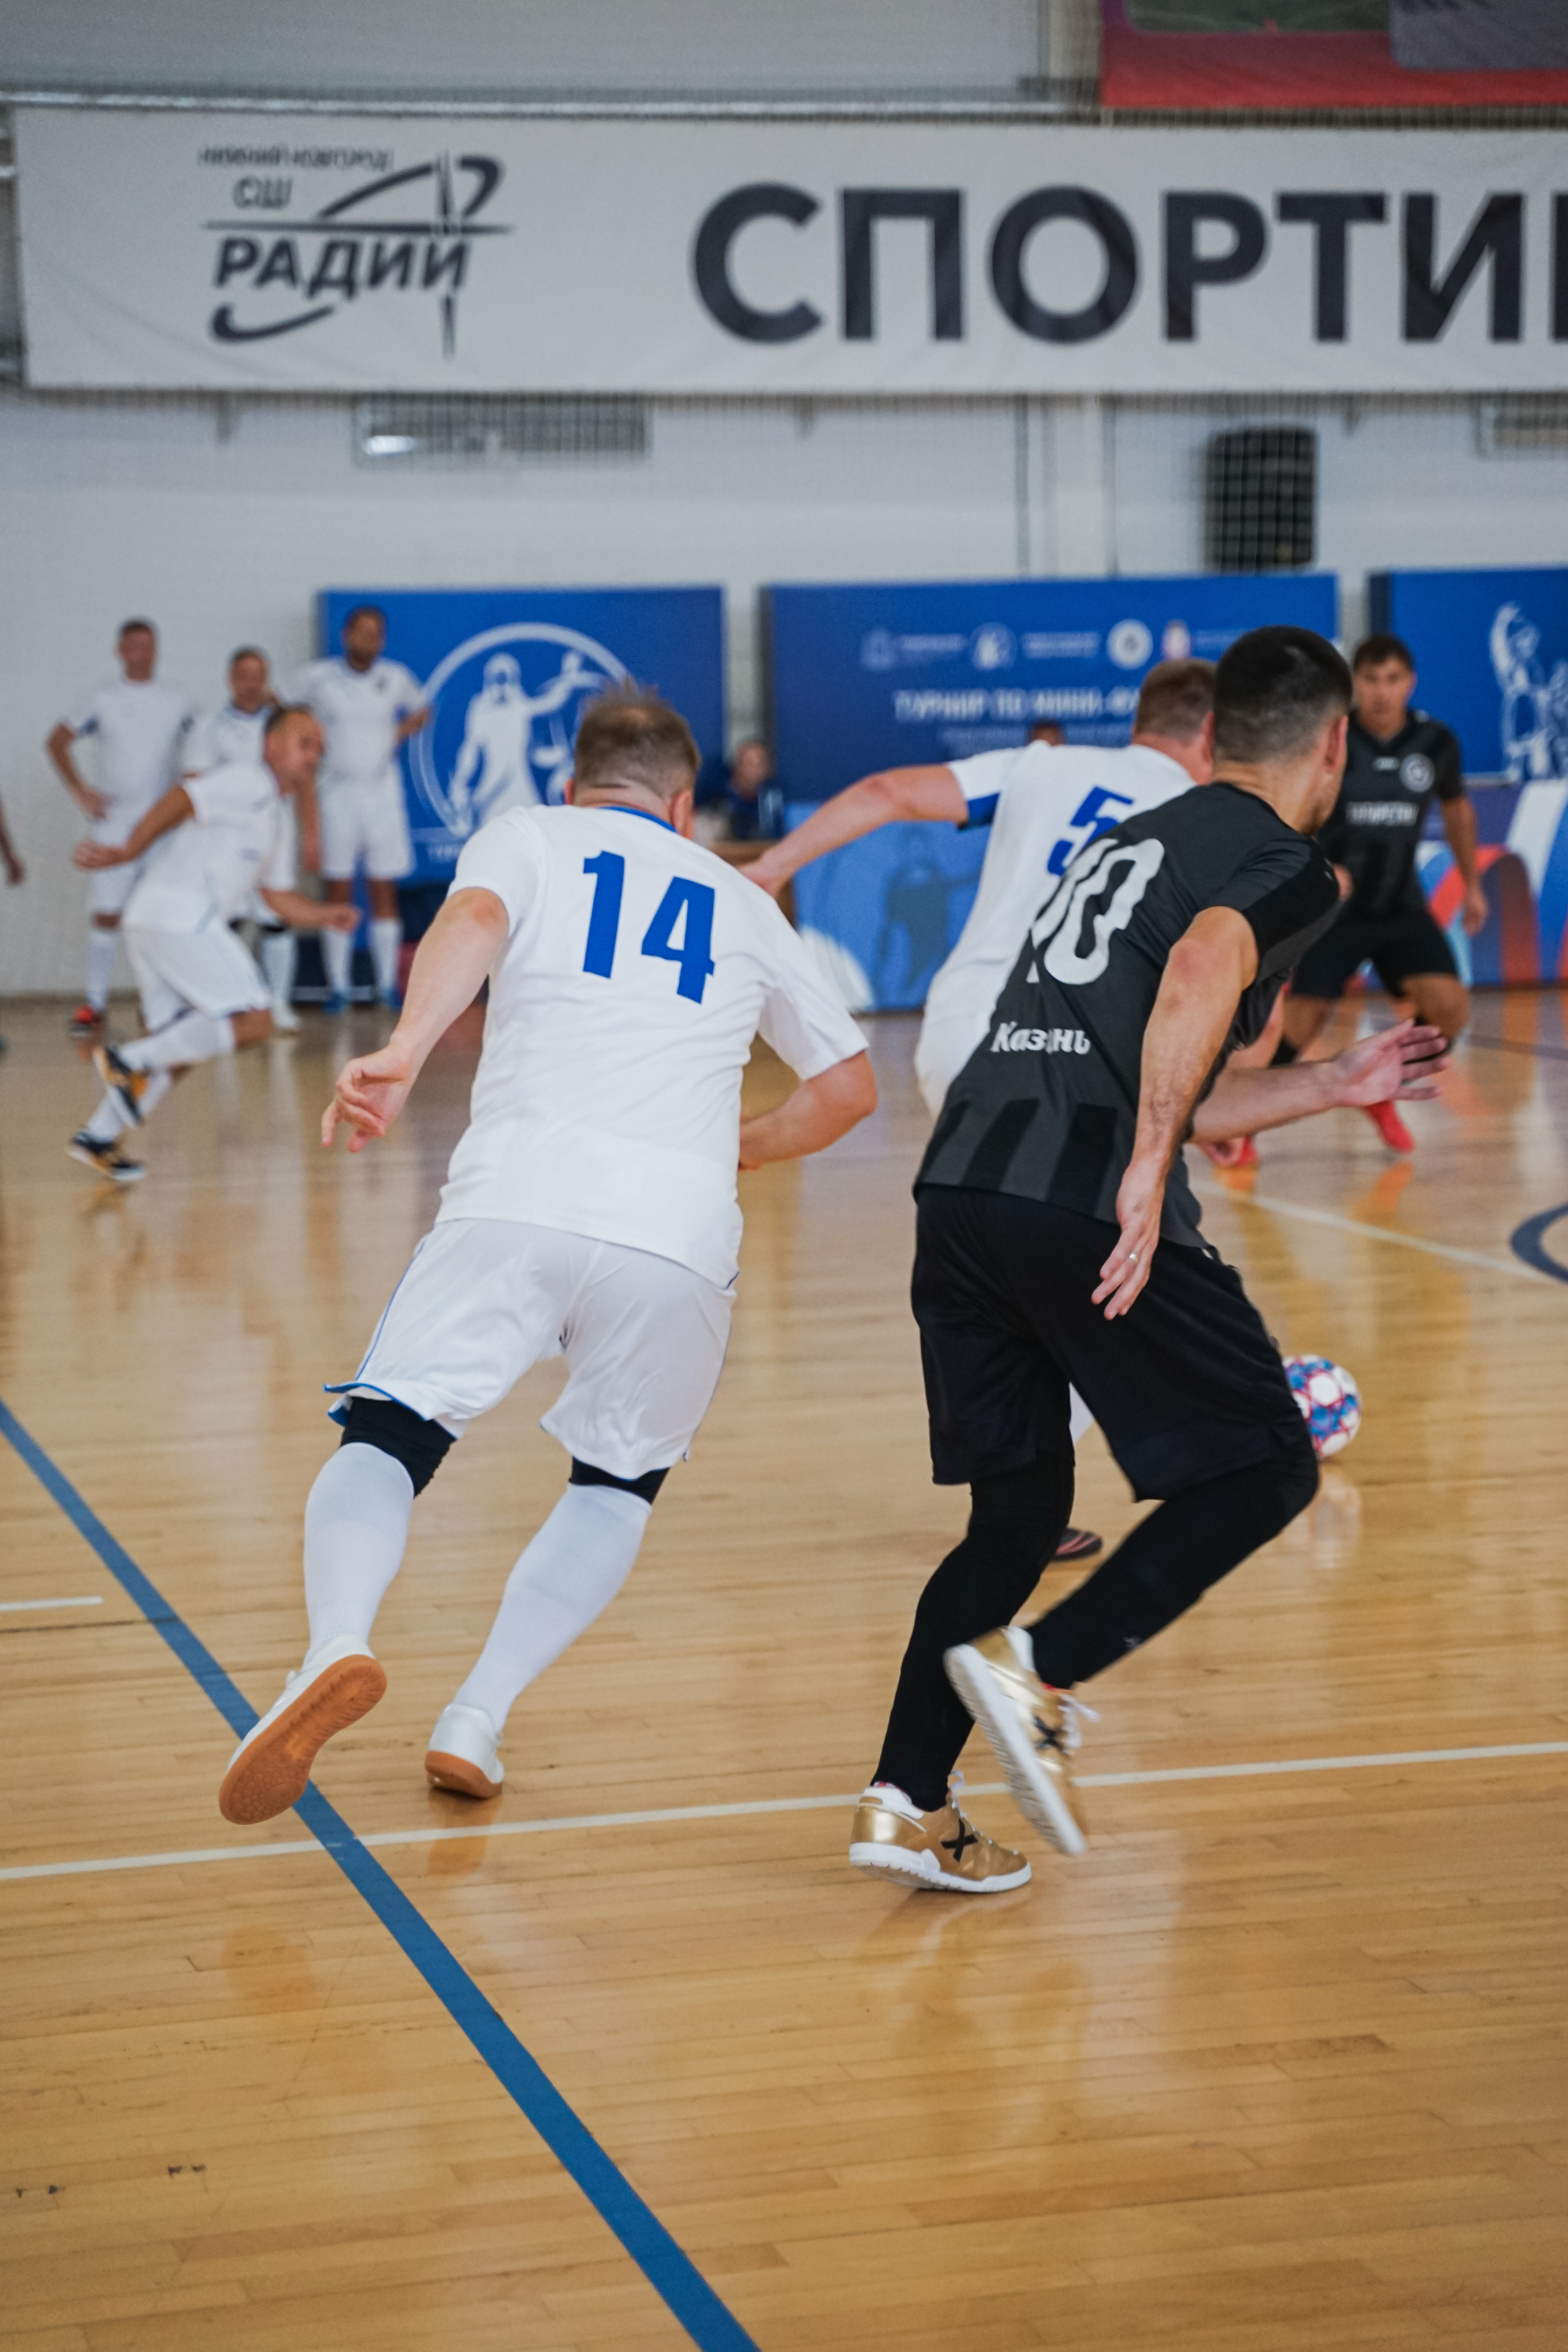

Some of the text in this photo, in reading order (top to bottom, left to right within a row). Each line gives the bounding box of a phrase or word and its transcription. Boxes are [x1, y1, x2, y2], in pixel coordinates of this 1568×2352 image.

[232, 176, 293, 209] СШ
[690, 181, 1568, 344] СПОРТИ
[1047, 786, 1134, 876] 5
[582, 849, 715, 1005] 14
[990, 1021, 1091, 1055] Казнь
